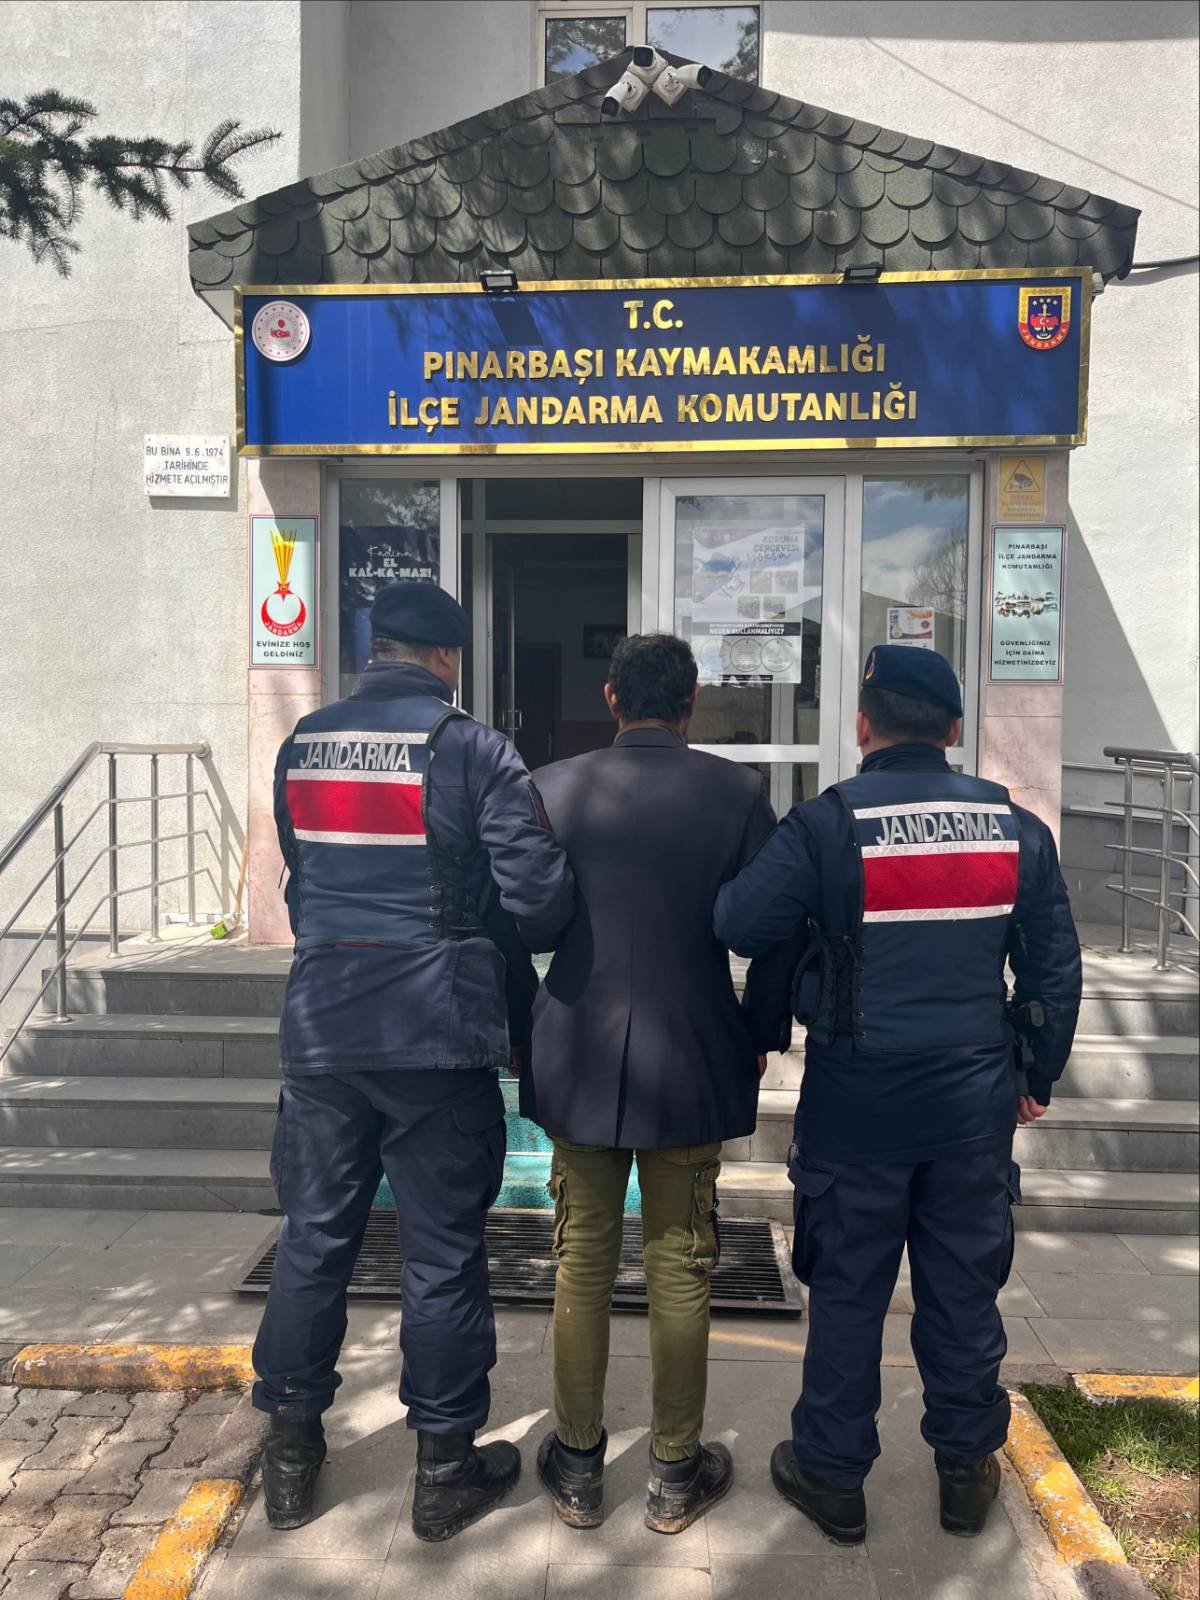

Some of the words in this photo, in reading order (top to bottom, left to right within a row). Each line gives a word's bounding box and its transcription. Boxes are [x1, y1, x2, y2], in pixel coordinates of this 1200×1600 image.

[623, 300, 684, 330] T.C.
[423, 349, 604, 385] PINARBAŞI
[616, 334, 886, 378] KAYMAKAMLIĞI
[388, 390, 460, 433] İLÇE
[473, 395, 664, 426] JANDARMA
[677, 382, 917, 424] KOMUTANLIĞI
[145, 446, 158, 456] BU
[160, 444, 181, 456] BİNA
[164, 459, 209, 471] TARİHİNDE
[145, 472, 183, 485] HİZMETE
[184, 474, 229, 487] AÇILMIŞTIR
[998, 552, 1015, 560] İLÇE
[383, 558, 398, 568] EL
[349, 567, 432, 578] KAL-KA-MAZ!
[256, 640, 291, 648] EVİNİZE
[293, 641, 312, 649] HOŞ
[263, 650, 304, 658] GELDİNİZ
[300, 741, 412, 771] JANDARMA
[875, 812, 1006, 846] JANDARMA
